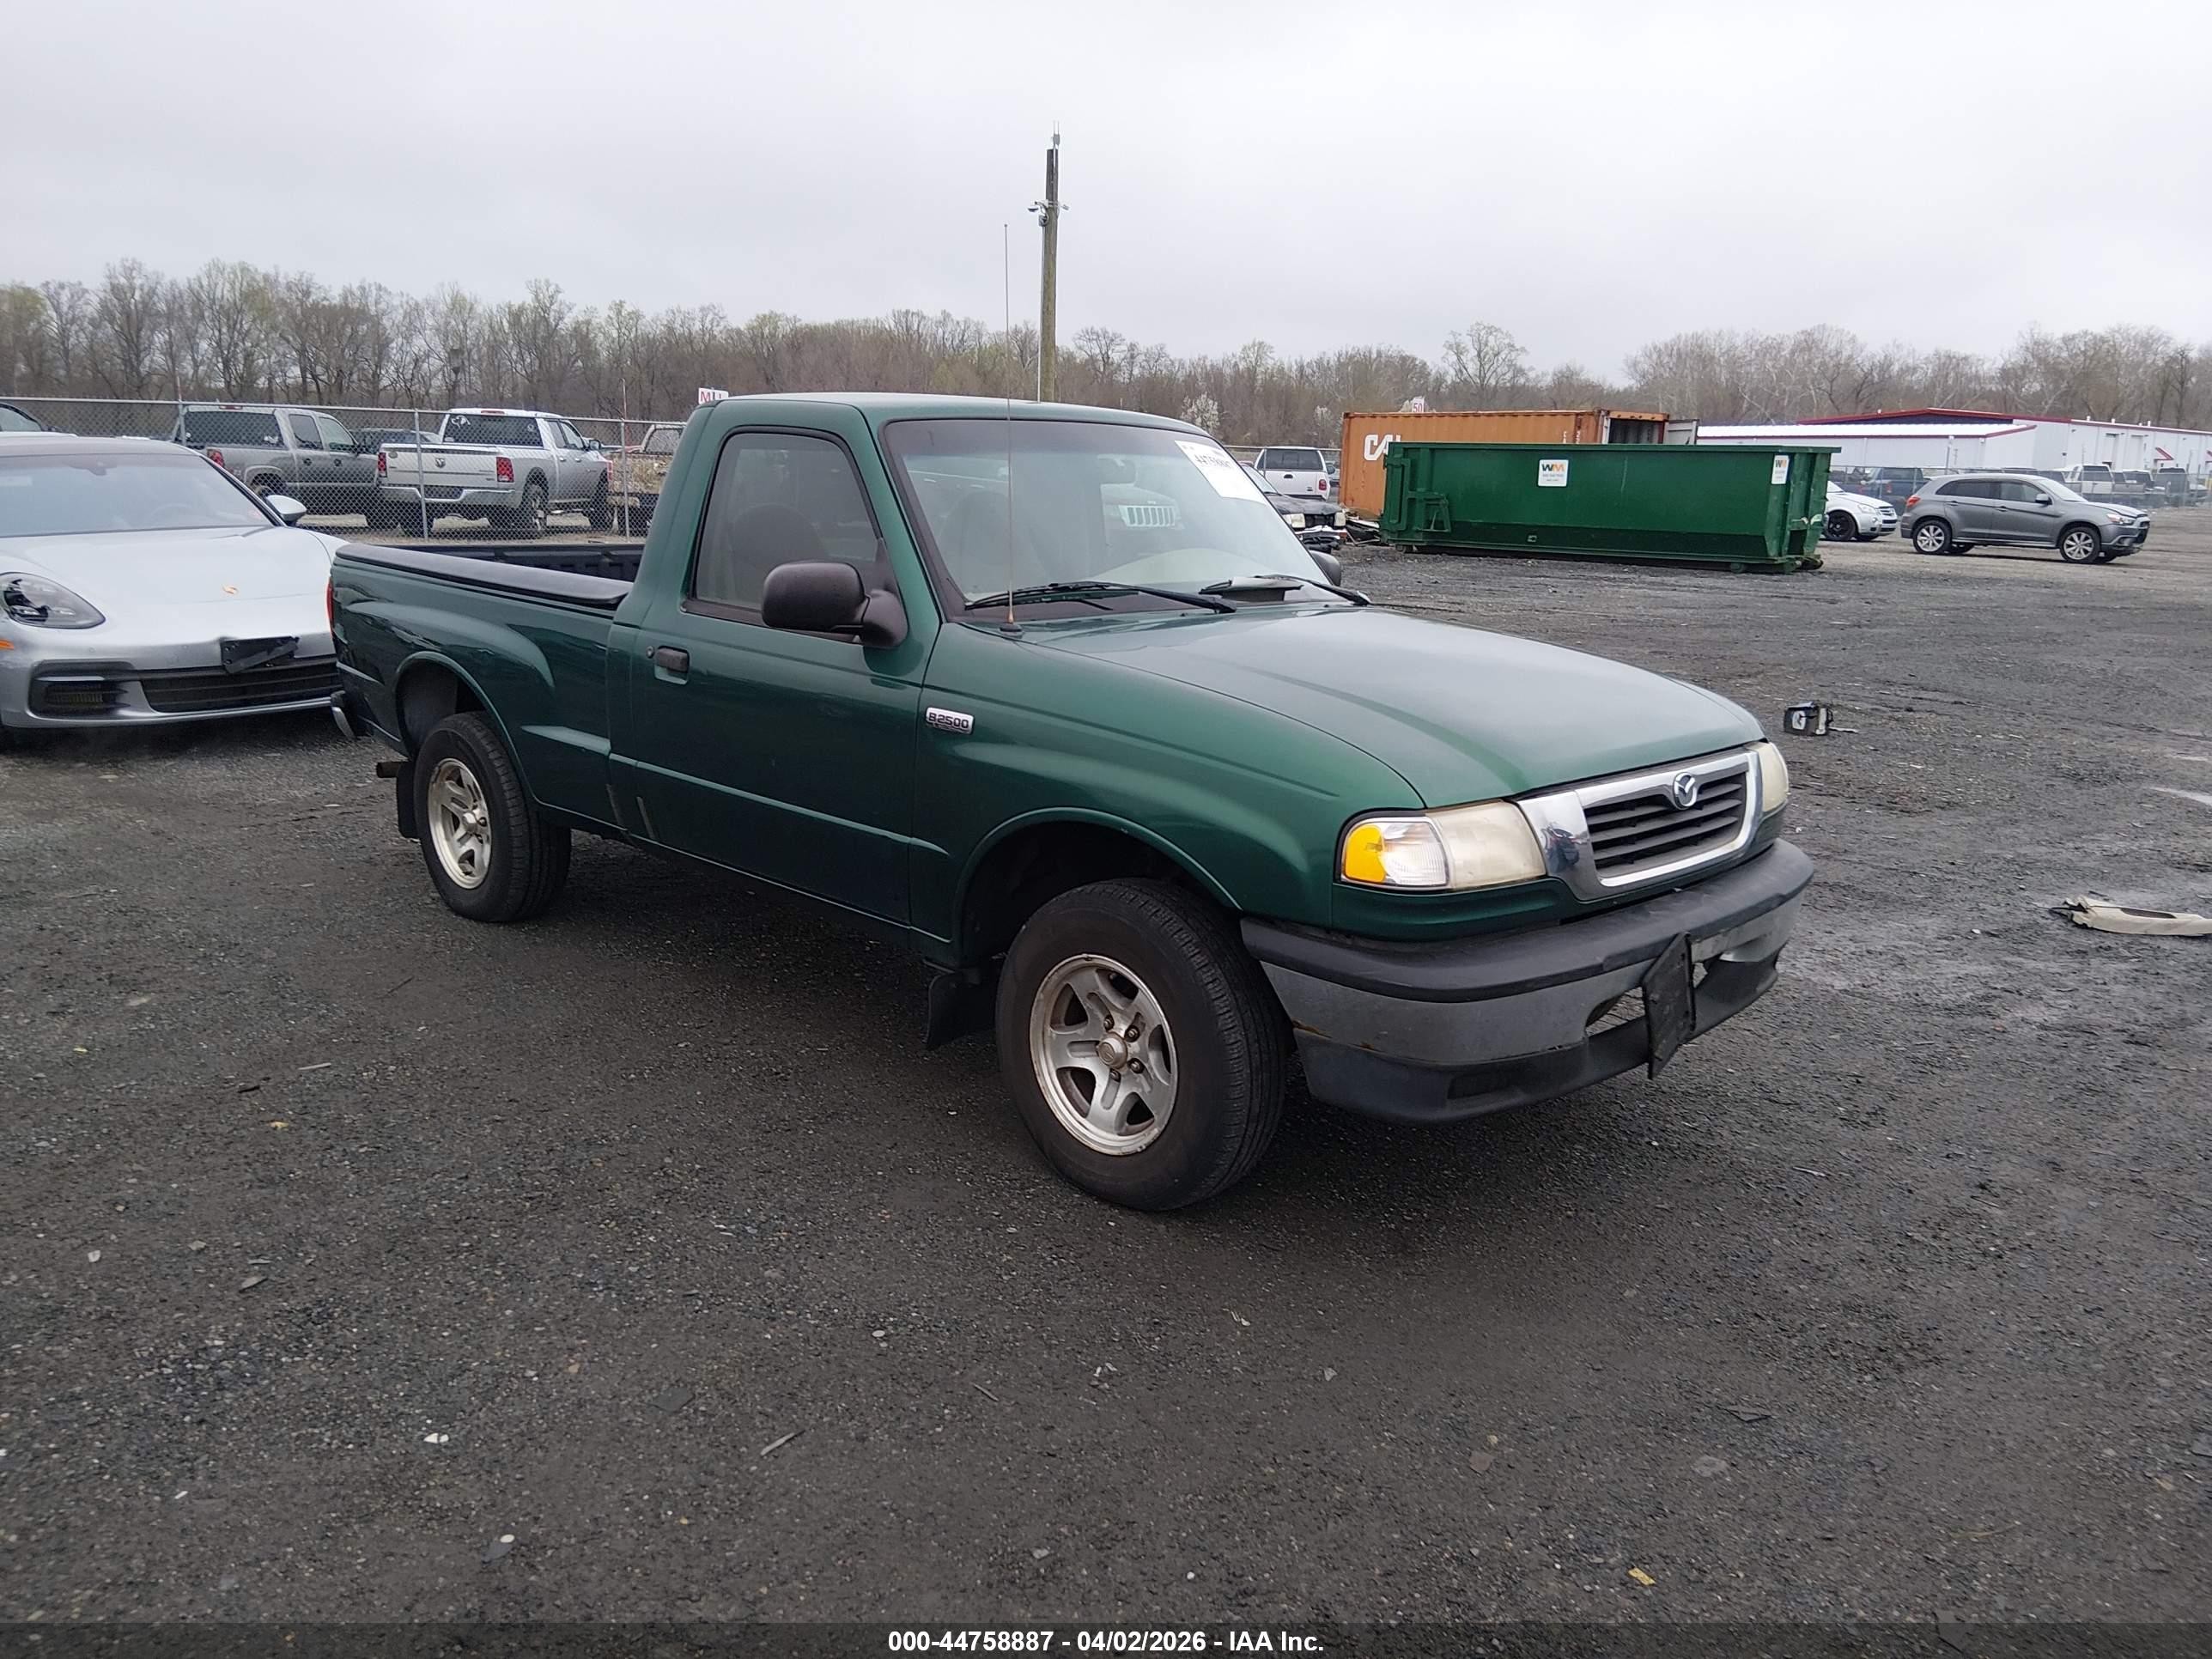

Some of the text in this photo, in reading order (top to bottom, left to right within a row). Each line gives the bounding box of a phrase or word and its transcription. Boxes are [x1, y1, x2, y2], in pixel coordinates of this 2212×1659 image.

[1413, 403, 1423, 412] 50
[1364, 434, 1401, 461] CA
[1541, 464, 1565, 472] WM
[928, 712, 969, 729] B2500
